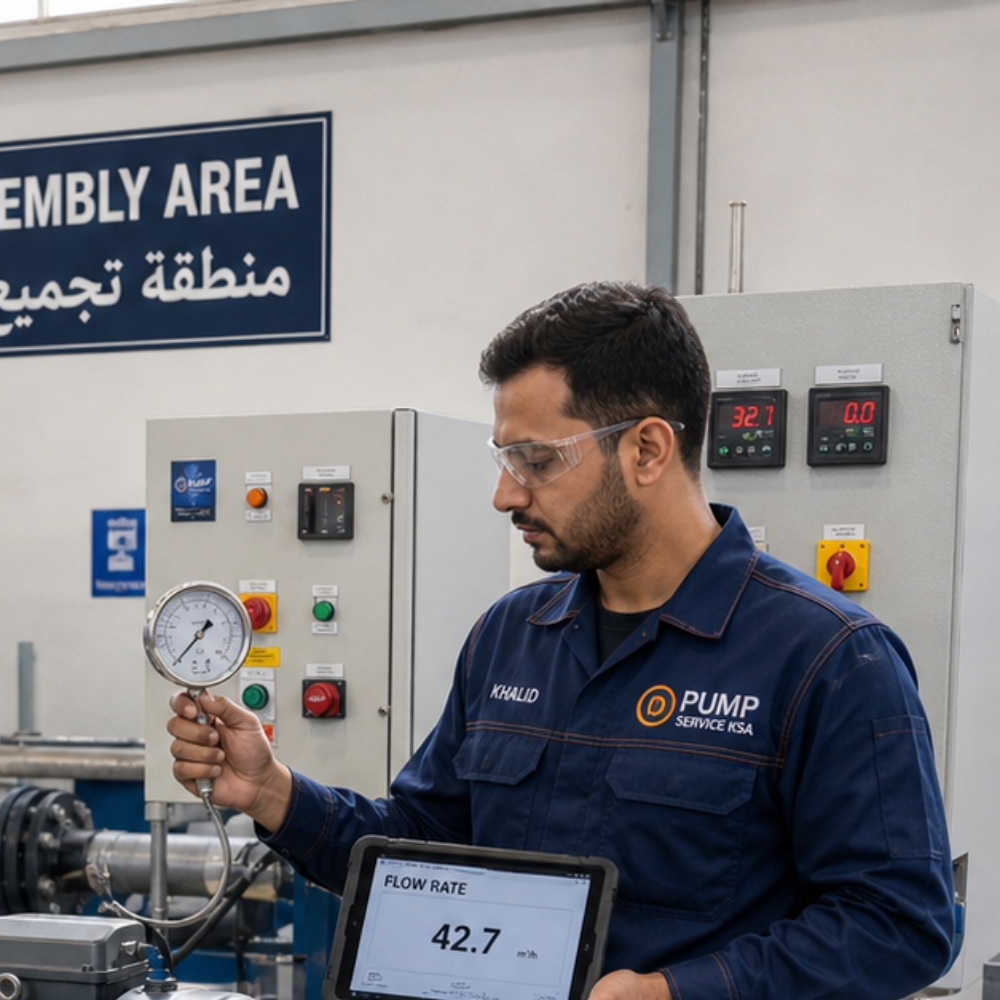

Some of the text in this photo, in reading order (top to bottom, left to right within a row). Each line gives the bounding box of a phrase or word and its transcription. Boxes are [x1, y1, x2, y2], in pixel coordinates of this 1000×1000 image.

[163, 154, 299, 219] AREA
[141, 246, 291, 303] منطقة
[843, 401, 876, 424] 0.0
[489, 683, 539, 704] KHALID
[679, 690, 760, 718] PUMP
[674, 715, 754, 736] SERVICE KSA
[384, 874, 468, 896] FLOW RATE
[431, 923, 501, 954] 42.7
